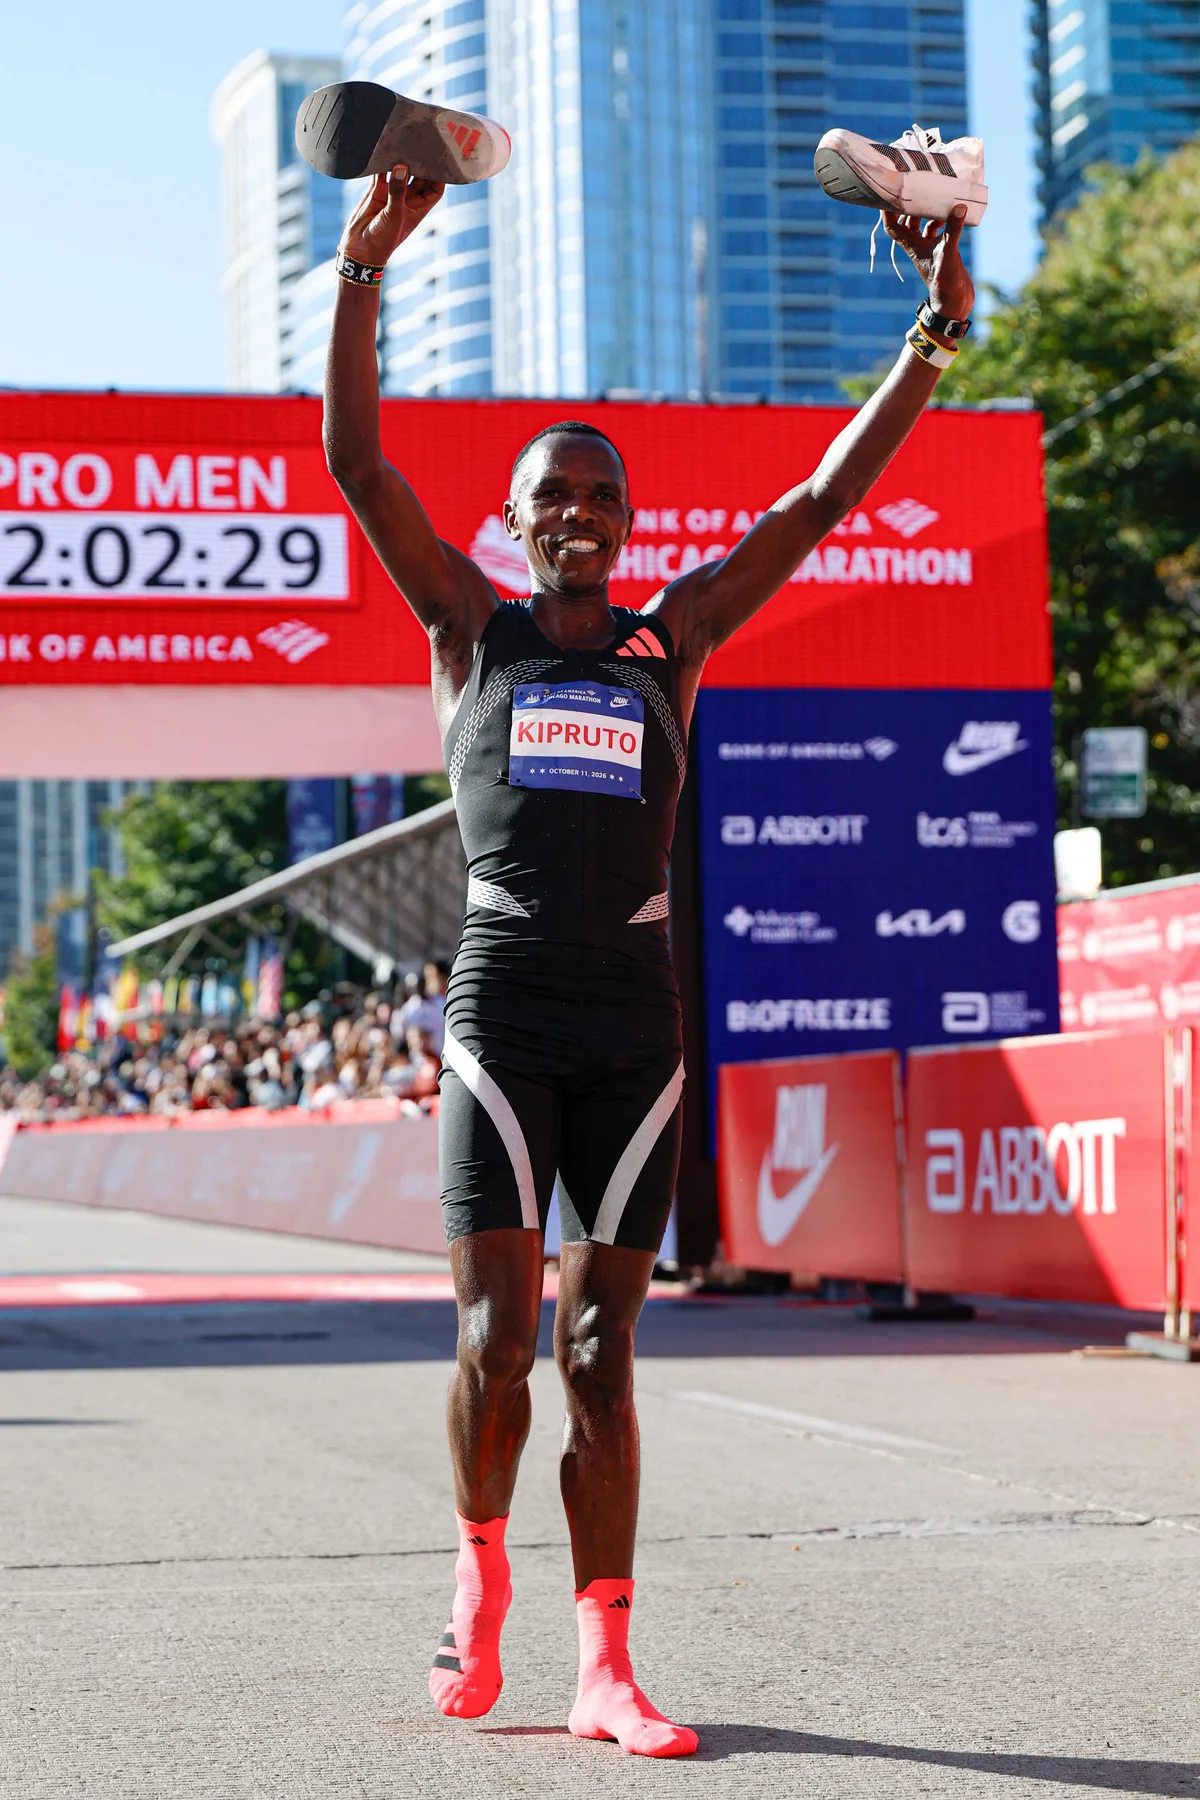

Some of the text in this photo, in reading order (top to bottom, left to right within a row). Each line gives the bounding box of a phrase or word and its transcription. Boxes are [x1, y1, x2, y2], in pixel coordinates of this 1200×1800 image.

[134, 453, 287, 509] MEN
[685, 508, 727, 535] OF
[4, 523, 323, 589] 2:02:29
[789, 546, 972, 585] ARATHON
[39, 633, 85, 662] OF
[92, 634, 253, 662] AMERICA
[569, 694, 602, 704] MARATHON
[613, 696, 628, 704] RUN
[517, 721, 637, 754] KIPRUTO
[549, 768, 580, 776] OCTOBER
[591, 771, 607, 779] 2026
[758, 815, 868, 845] ABBOTT
[972, 1117, 1126, 1215] ABBOTT
